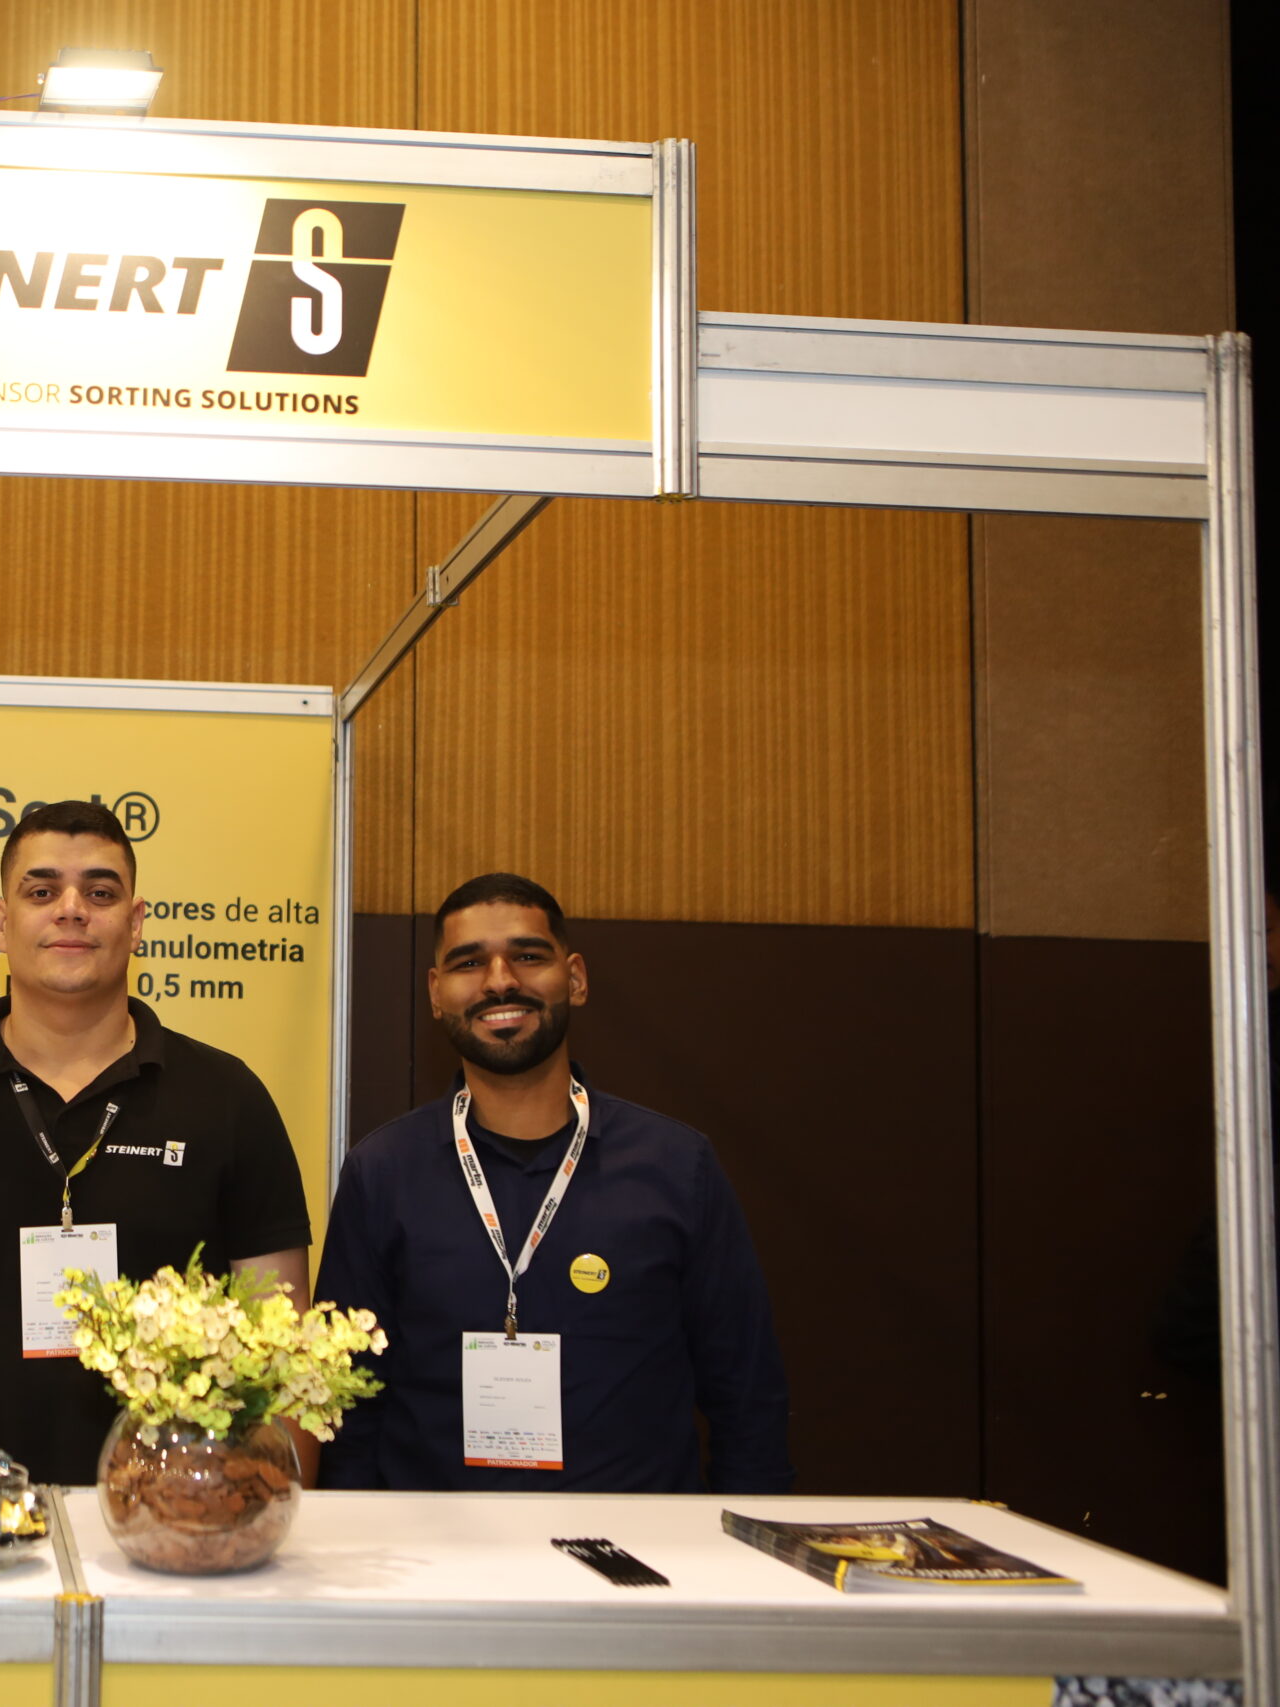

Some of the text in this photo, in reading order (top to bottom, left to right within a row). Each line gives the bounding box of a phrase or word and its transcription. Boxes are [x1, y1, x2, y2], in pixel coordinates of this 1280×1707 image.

[69, 384, 192, 407] SORTING
[201, 390, 359, 415] SOLUTIONS
[225, 897, 259, 922] de
[268, 898, 320, 924] alta
[133, 934, 304, 962] anulometria
[137, 972, 180, 1002] 0,5
[190, 979, 244, 999] mm
[105, 1144, 163, 1157] STEINERT
